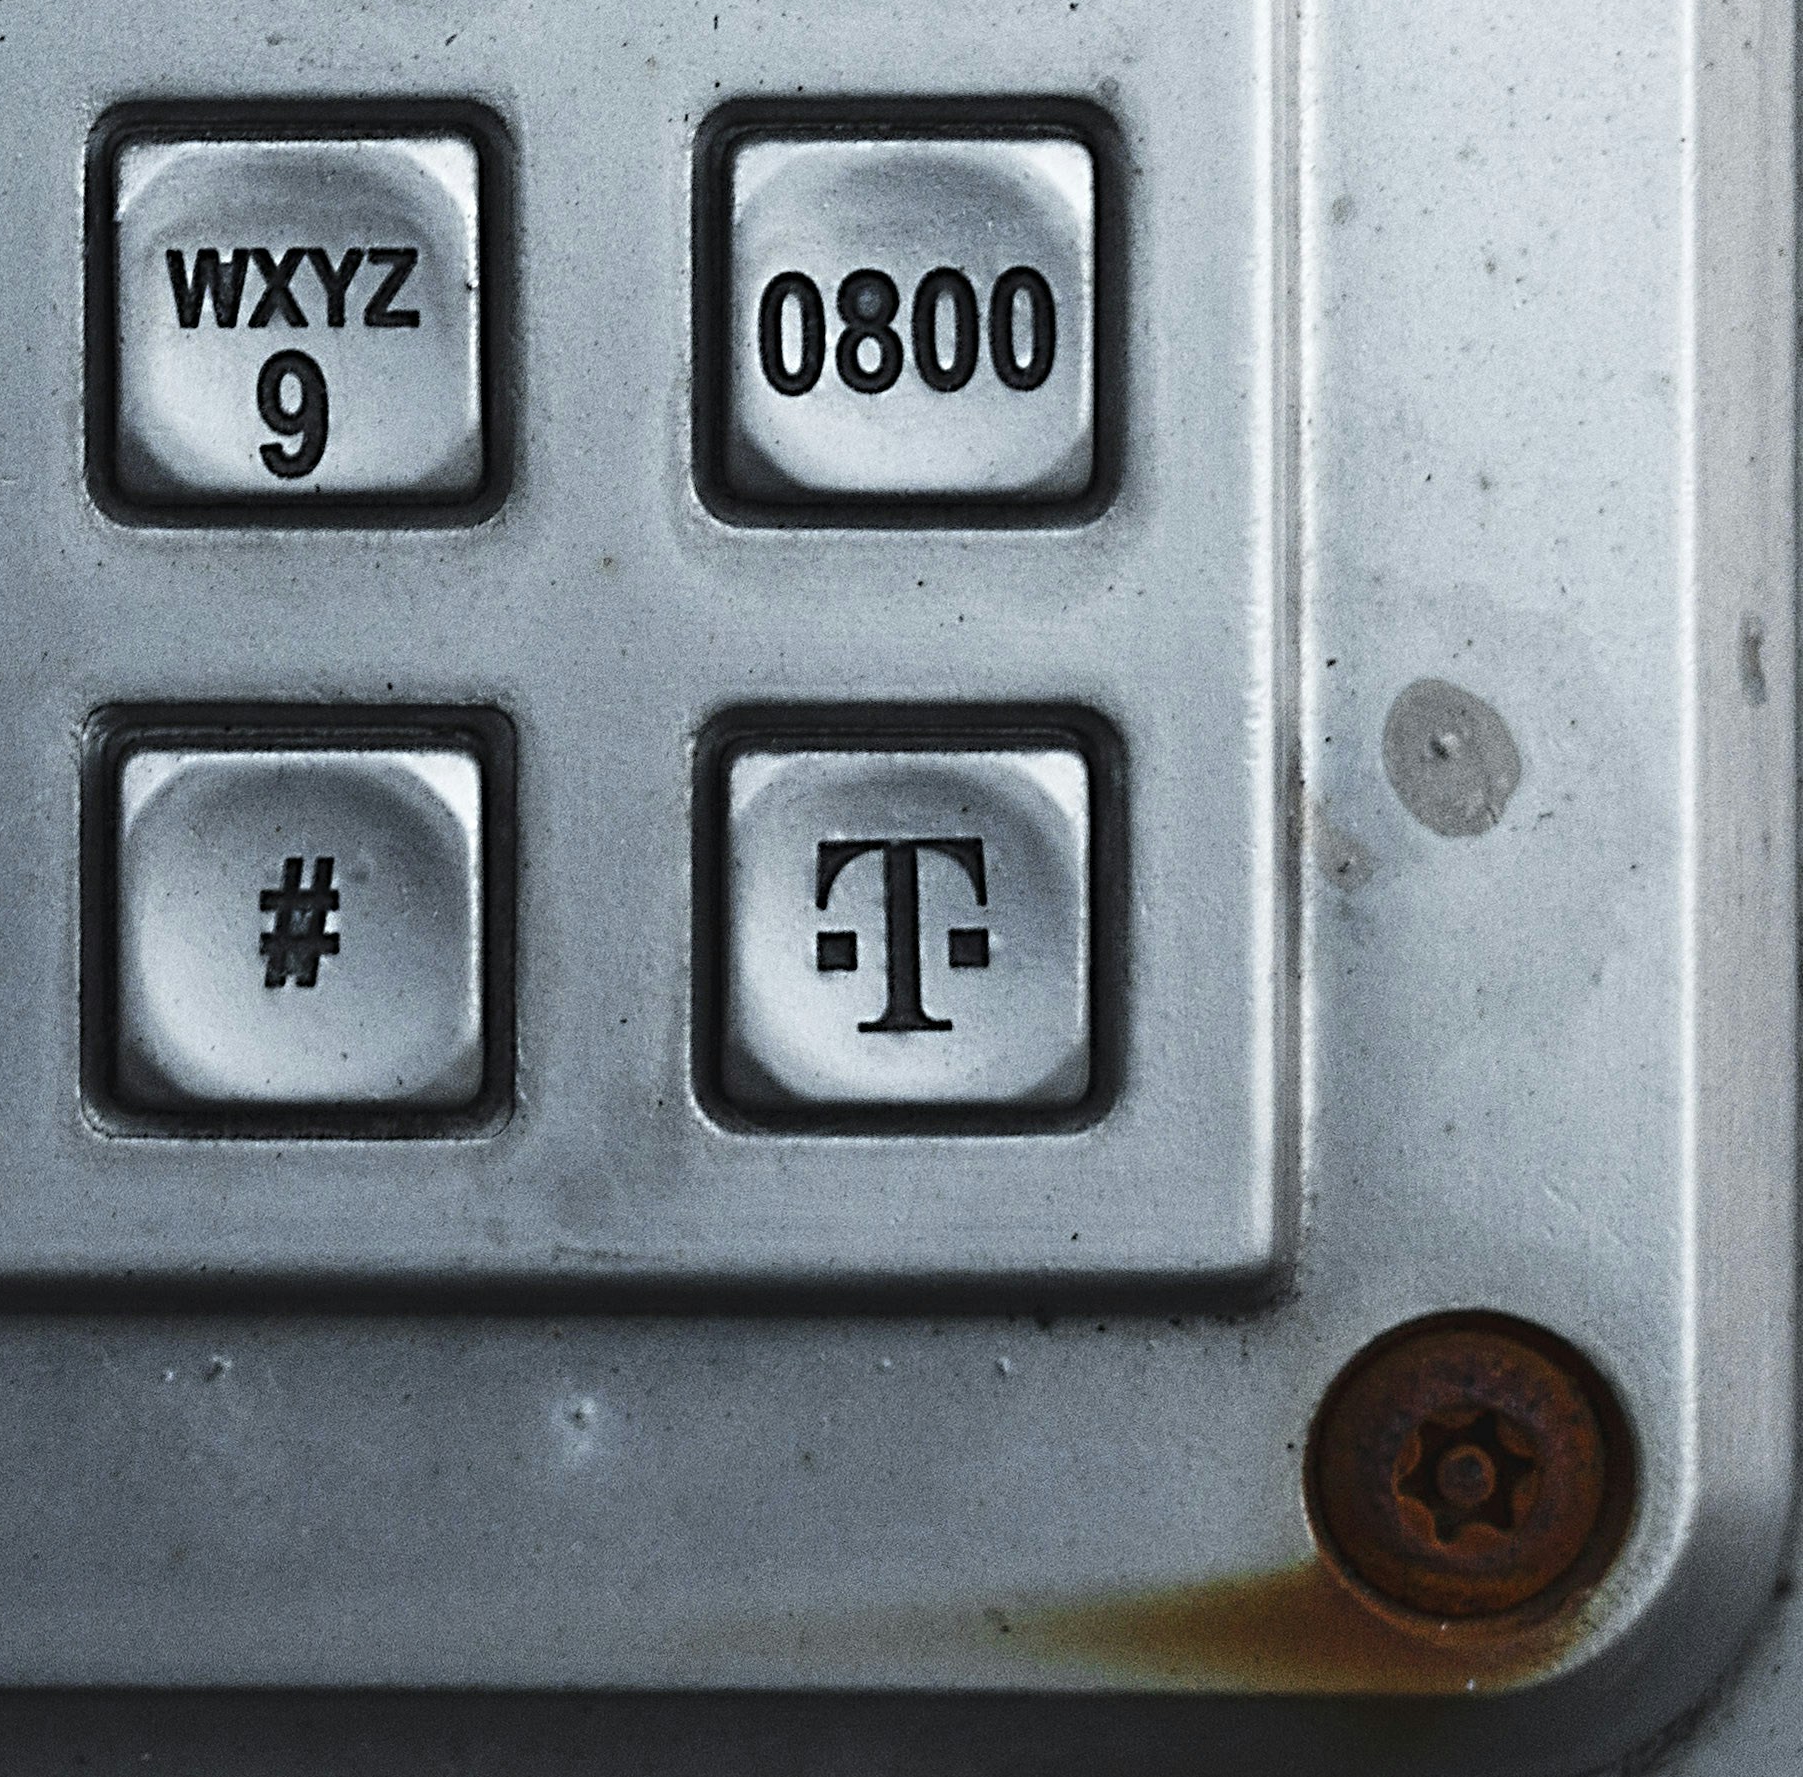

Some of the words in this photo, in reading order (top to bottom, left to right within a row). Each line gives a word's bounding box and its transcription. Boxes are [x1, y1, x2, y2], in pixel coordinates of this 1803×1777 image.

[166, 247, 420, 329] WXYZ
[759, 266, 1057, 396] 0800
[255, 349, 330, 481] 9
